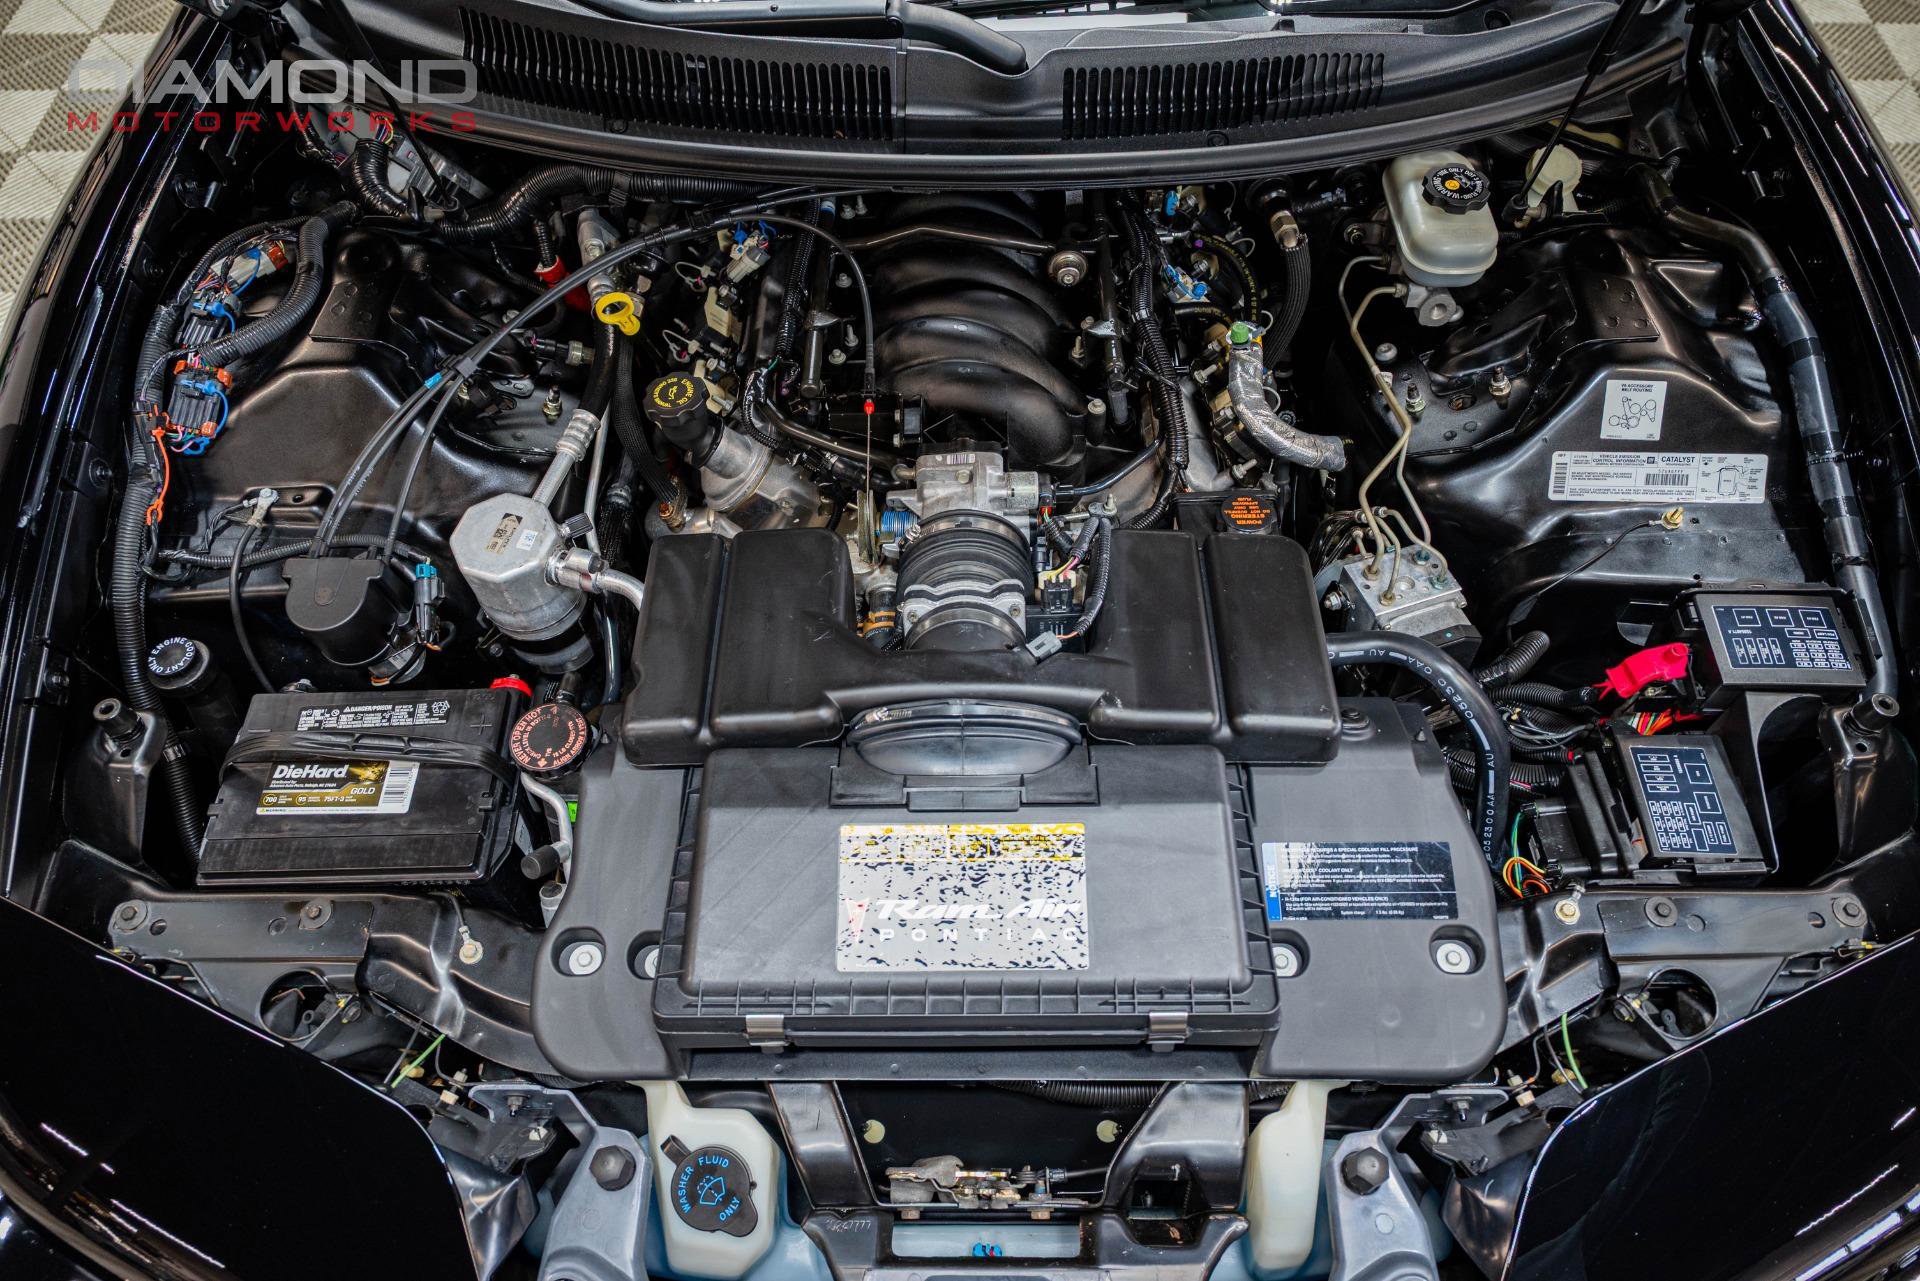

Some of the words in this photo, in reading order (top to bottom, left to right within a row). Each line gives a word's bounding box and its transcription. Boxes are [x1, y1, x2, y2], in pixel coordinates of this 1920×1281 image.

[1464, 170, 1476, 179] DOT
[1432, 176, 1460, 200] WARNING
[681, 378, 694, 398] ENGINE
[676, 397, 688, 405] OIL
[151, 636, 188, 655] ENGINE
[1369, 648, 1386, 657] AU
[148, 656, 164, 673] ONLY
[165, 641, 194, 674] COOLANT
[526, 707, 541, 721] HOT
[513, 721, 527, 740] OPEN
[522, 731, 530, 747] LEVEL
[512, 742, 531, 764] NEVER
[524, 746, 541, 759] CHECK
[553, 753, 571, 767] ALIGN
[570, 735, 585, 756] ARROW
[1485, 754, 1495, 768] AU
[273, 764, 349, 779] DieHard
[350, 787, 376, 795] GOLD
[1267, 865, 1278, 898] NOTICE
[875, 899, 1002, 920] Ram
[1006, 898, 1081, 920] Air
[879, 928, 1077, 942] PONTIAC
[698, 1155, 729, 1168] FLUID
[678, 1166, 694, 1213] WASHER
[719, 1196, 740, 1221] ONLY
